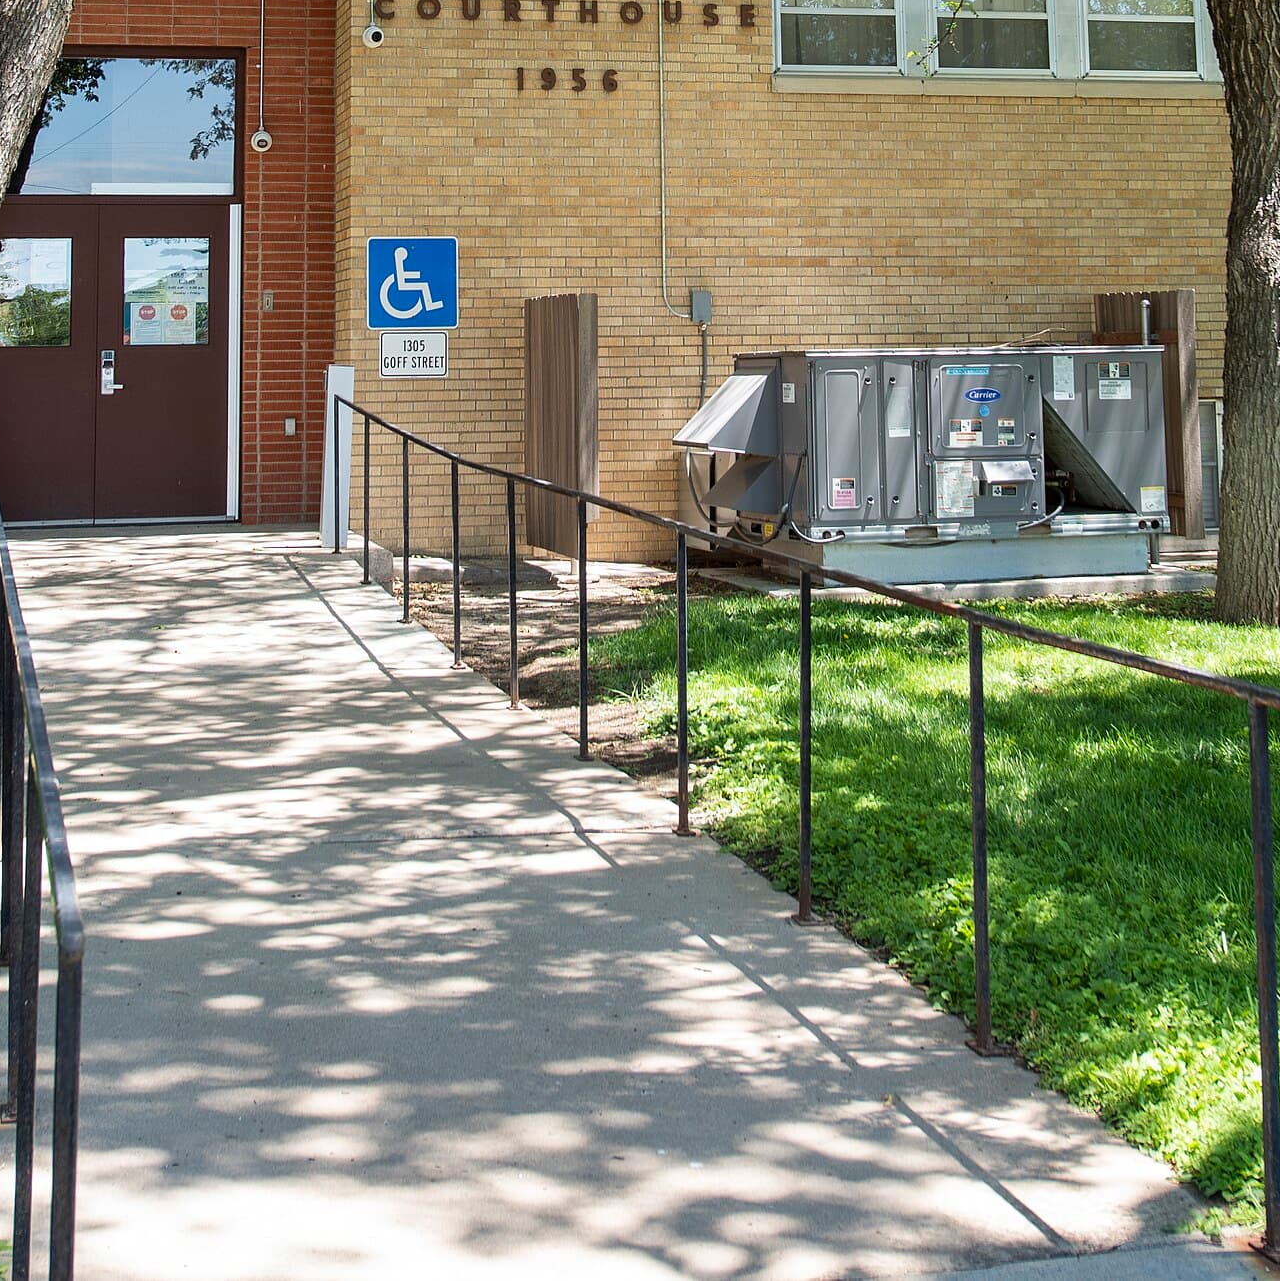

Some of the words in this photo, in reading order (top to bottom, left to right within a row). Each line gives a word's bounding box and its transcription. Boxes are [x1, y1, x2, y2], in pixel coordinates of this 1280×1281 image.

[516, 66, 619, 93] 1956
[403, 340, 425, 352] 1305
[383, 356, 408, 369] GOFF
[411, 356, 445, 369] STREET
[969, 391, 998, 399] Carrier
